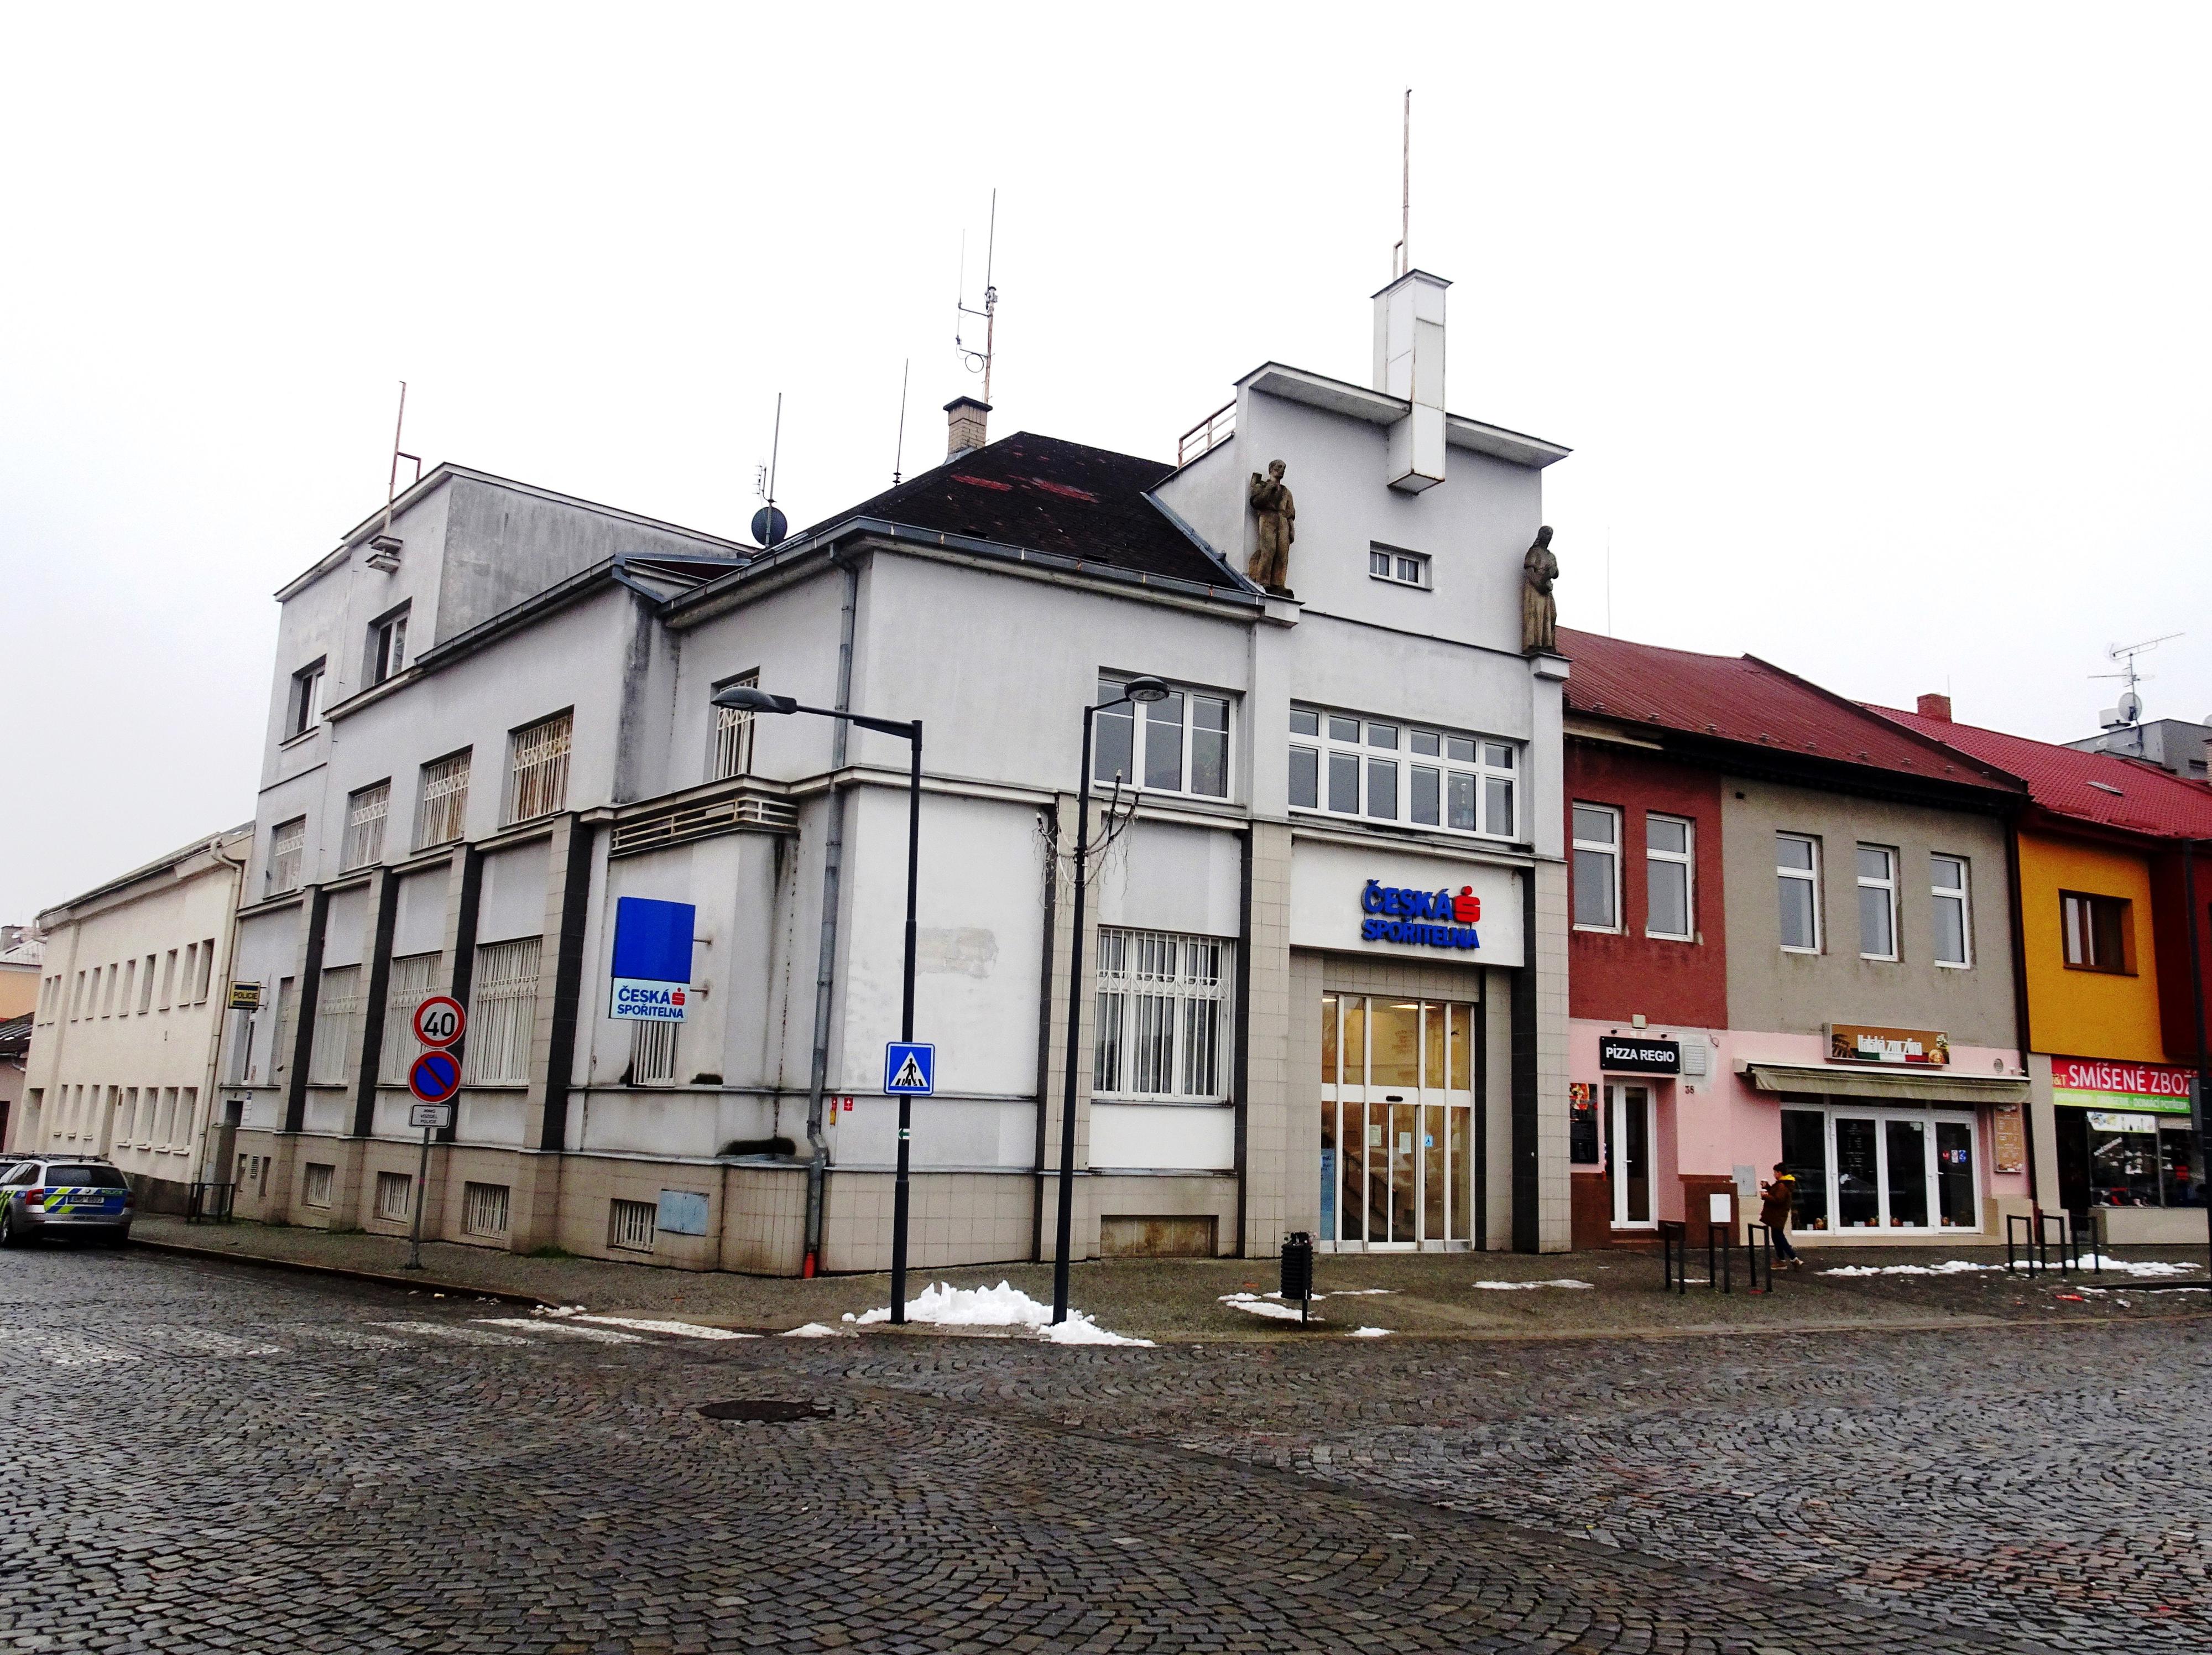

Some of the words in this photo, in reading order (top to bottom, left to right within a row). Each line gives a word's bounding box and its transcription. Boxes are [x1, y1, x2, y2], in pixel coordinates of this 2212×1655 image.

[1361, 879, 1453, 920] ČESKÁ
[1363, 915, 1480, 949] SPOŘITELNA
[234, 991, 258, 1000] POLICIE
[618, 985, 670, 1005] ČESKÁ
[617, 1003, 684, 1018] SPOŘITELNA
[423, 1012, 455, 1037] 40
[1640, 1049, 1675, 1062] REGIO
[2069, 1062, 2147, 1092] SMÍŠENÉ
[2151, 1070, 2198, 1095] ZBOŽ
[1685, 1085, 1694, 1094] 38
